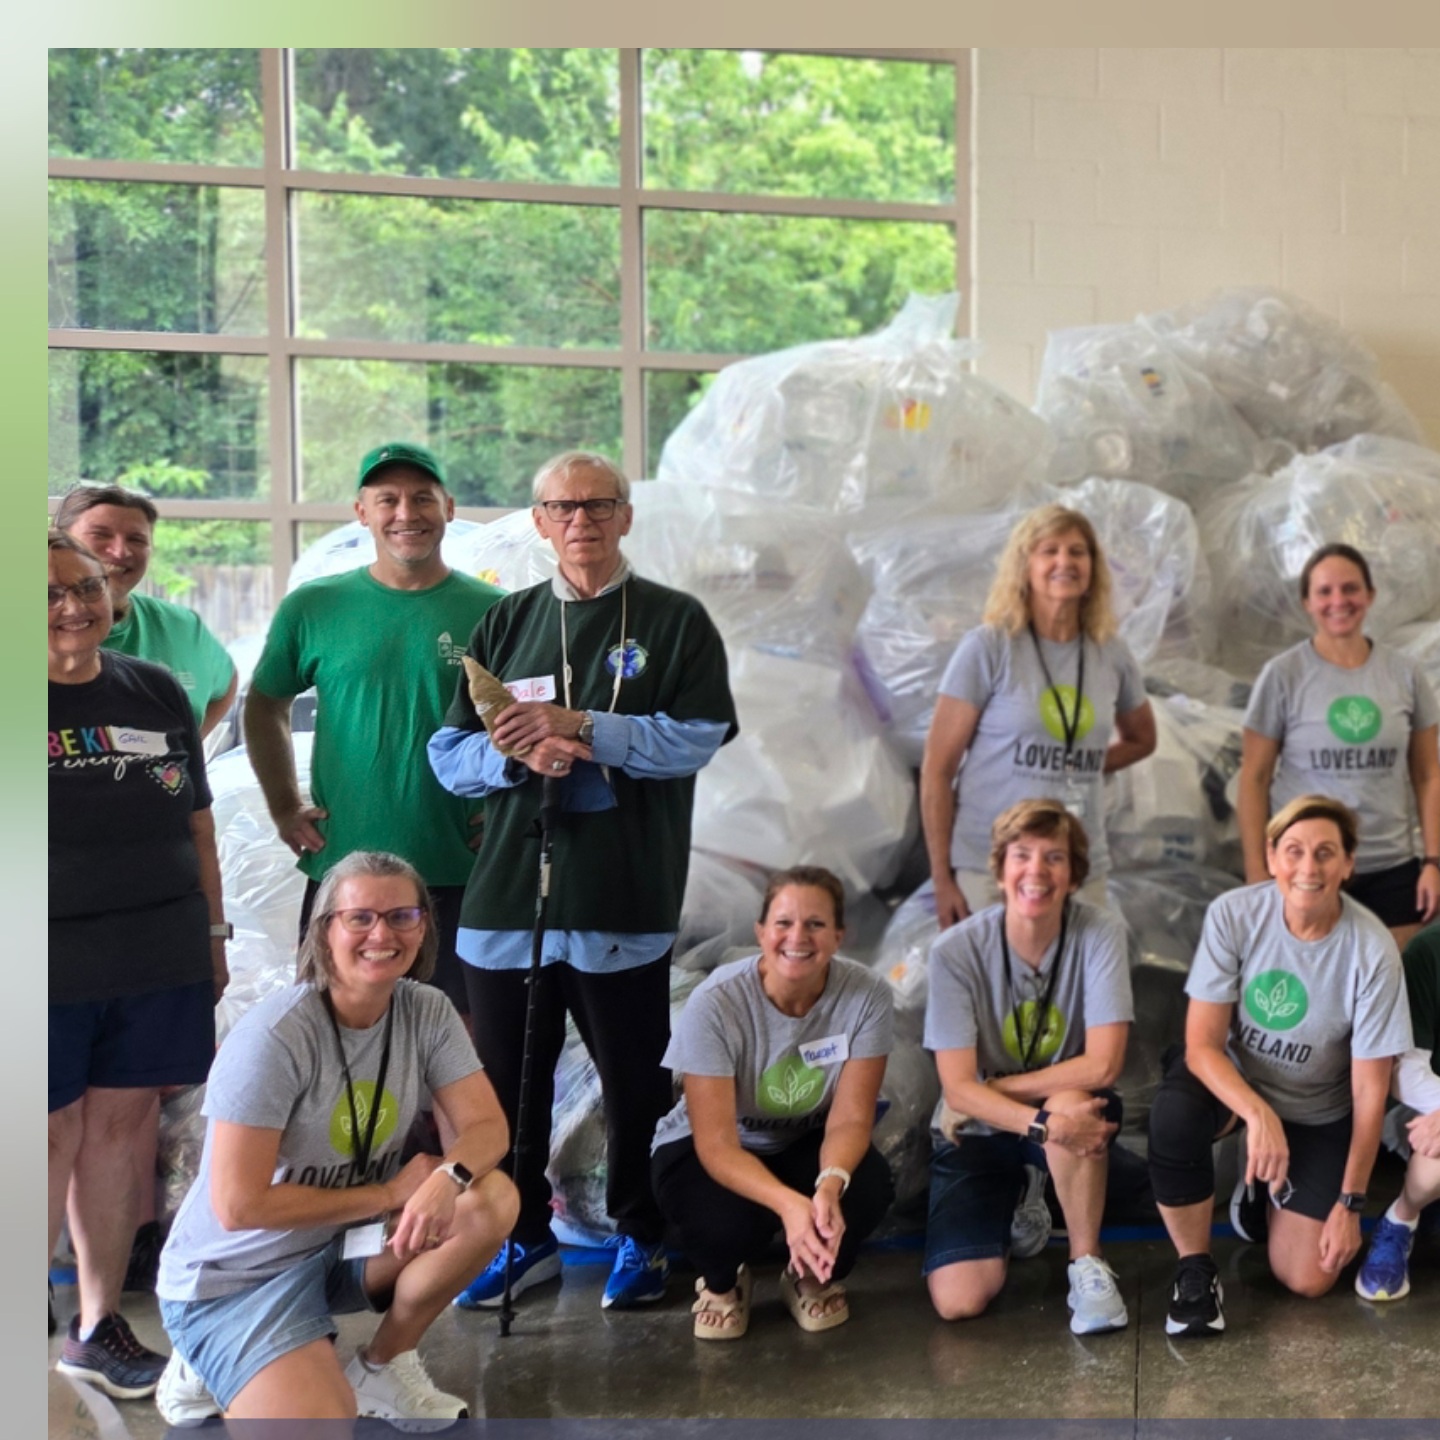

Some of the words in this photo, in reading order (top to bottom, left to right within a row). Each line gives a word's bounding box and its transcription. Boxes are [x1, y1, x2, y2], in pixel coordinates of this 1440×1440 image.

[506, 684, 547, 699] Dale
[81, 727, 113, 753] KI
[1309, 748, 1398, 770] LOVELAND
[1239, 1022, 1313, 1064] VELAND
